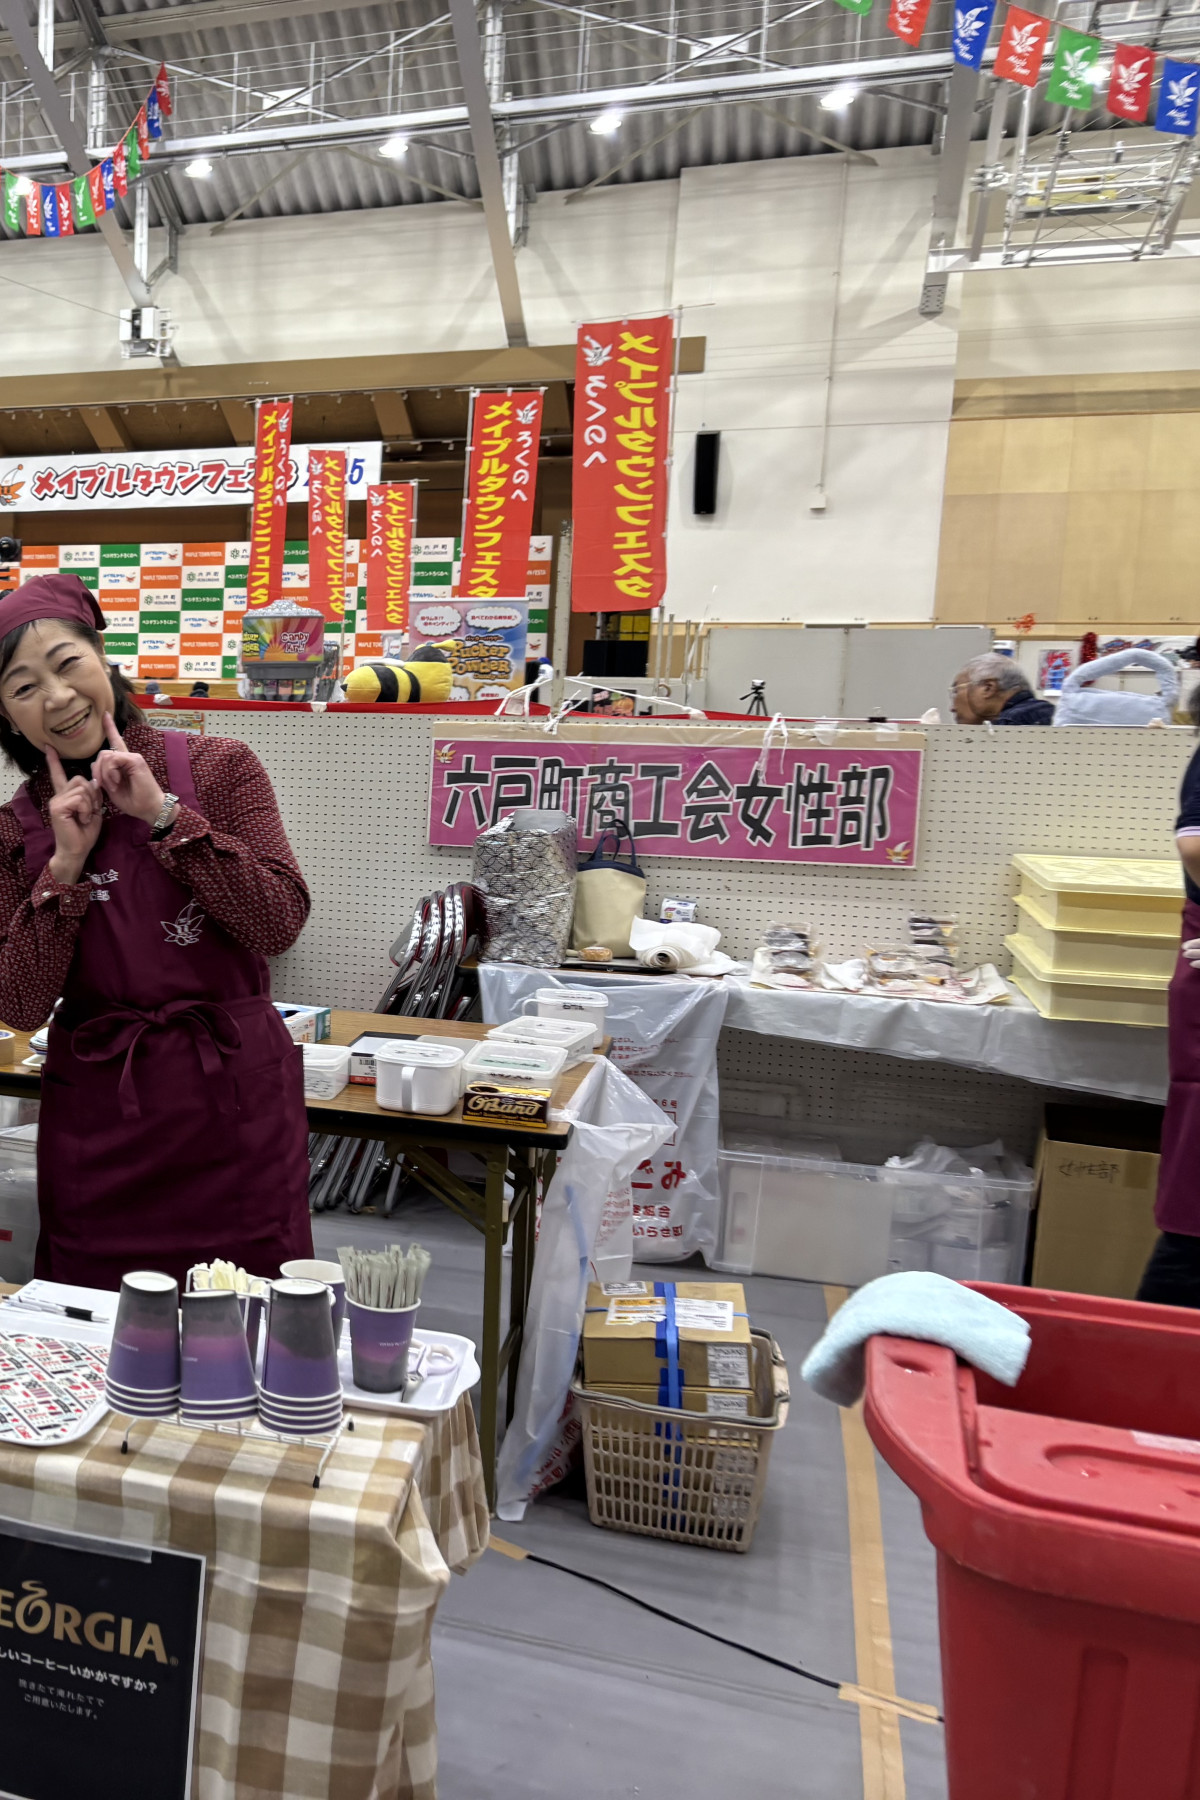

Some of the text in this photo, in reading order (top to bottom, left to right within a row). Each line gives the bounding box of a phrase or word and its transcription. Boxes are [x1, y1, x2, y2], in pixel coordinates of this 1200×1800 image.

[31, 459, 299, 500] メイプルタウンフェ
[510, 430, 534, 501] ろくのへ
[467, 400, 513, 598] メイプルタウンフェスタ
[444, 755, 894, 850] 六戸町商工会女性部
[89, 889, 110, 902] 性部
[633, 1225, 683, 1238] いらせ町
[23, 1693, 99, 1721] ご用意いたします。
